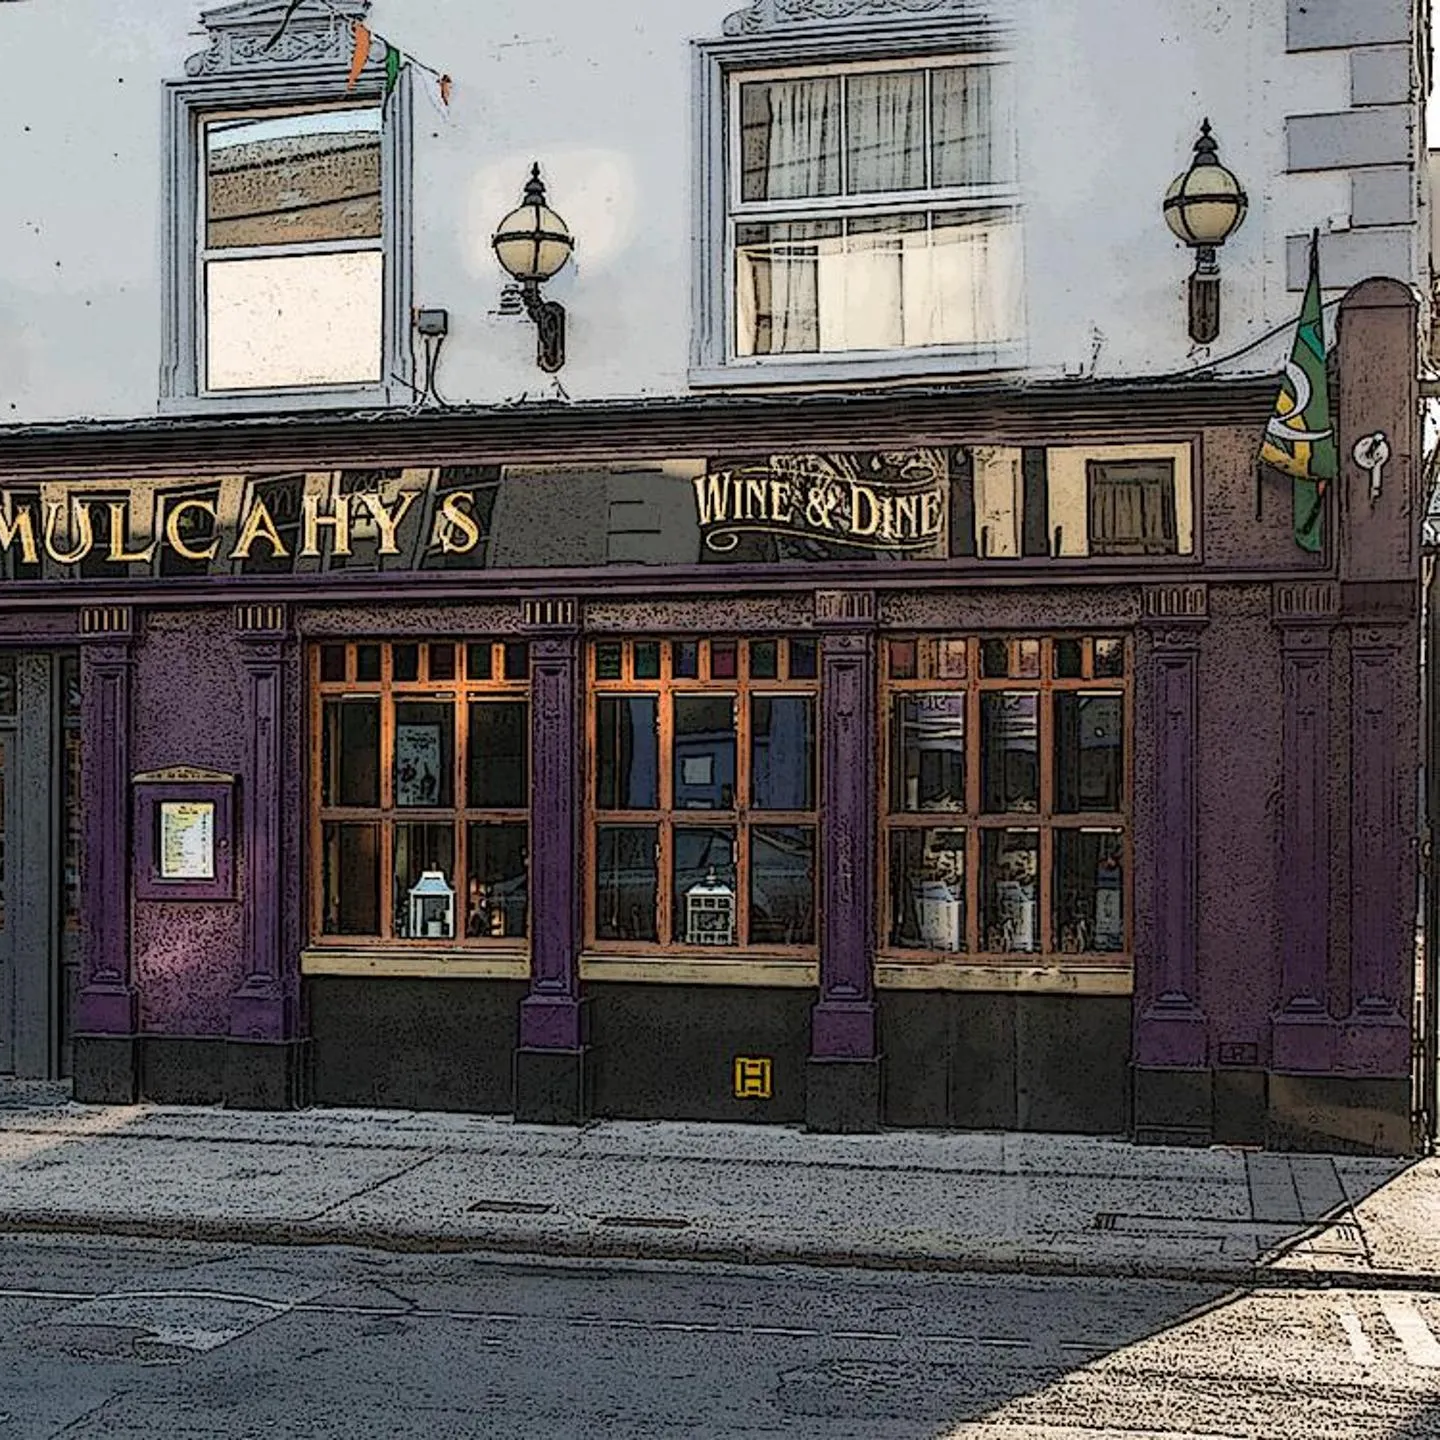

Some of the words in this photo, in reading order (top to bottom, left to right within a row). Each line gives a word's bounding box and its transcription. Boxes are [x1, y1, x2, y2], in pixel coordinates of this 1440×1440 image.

[693, 471, 792, 526] WINE
[805, 483, 835, 529] &
[848, 486, 944, 540] DINE
